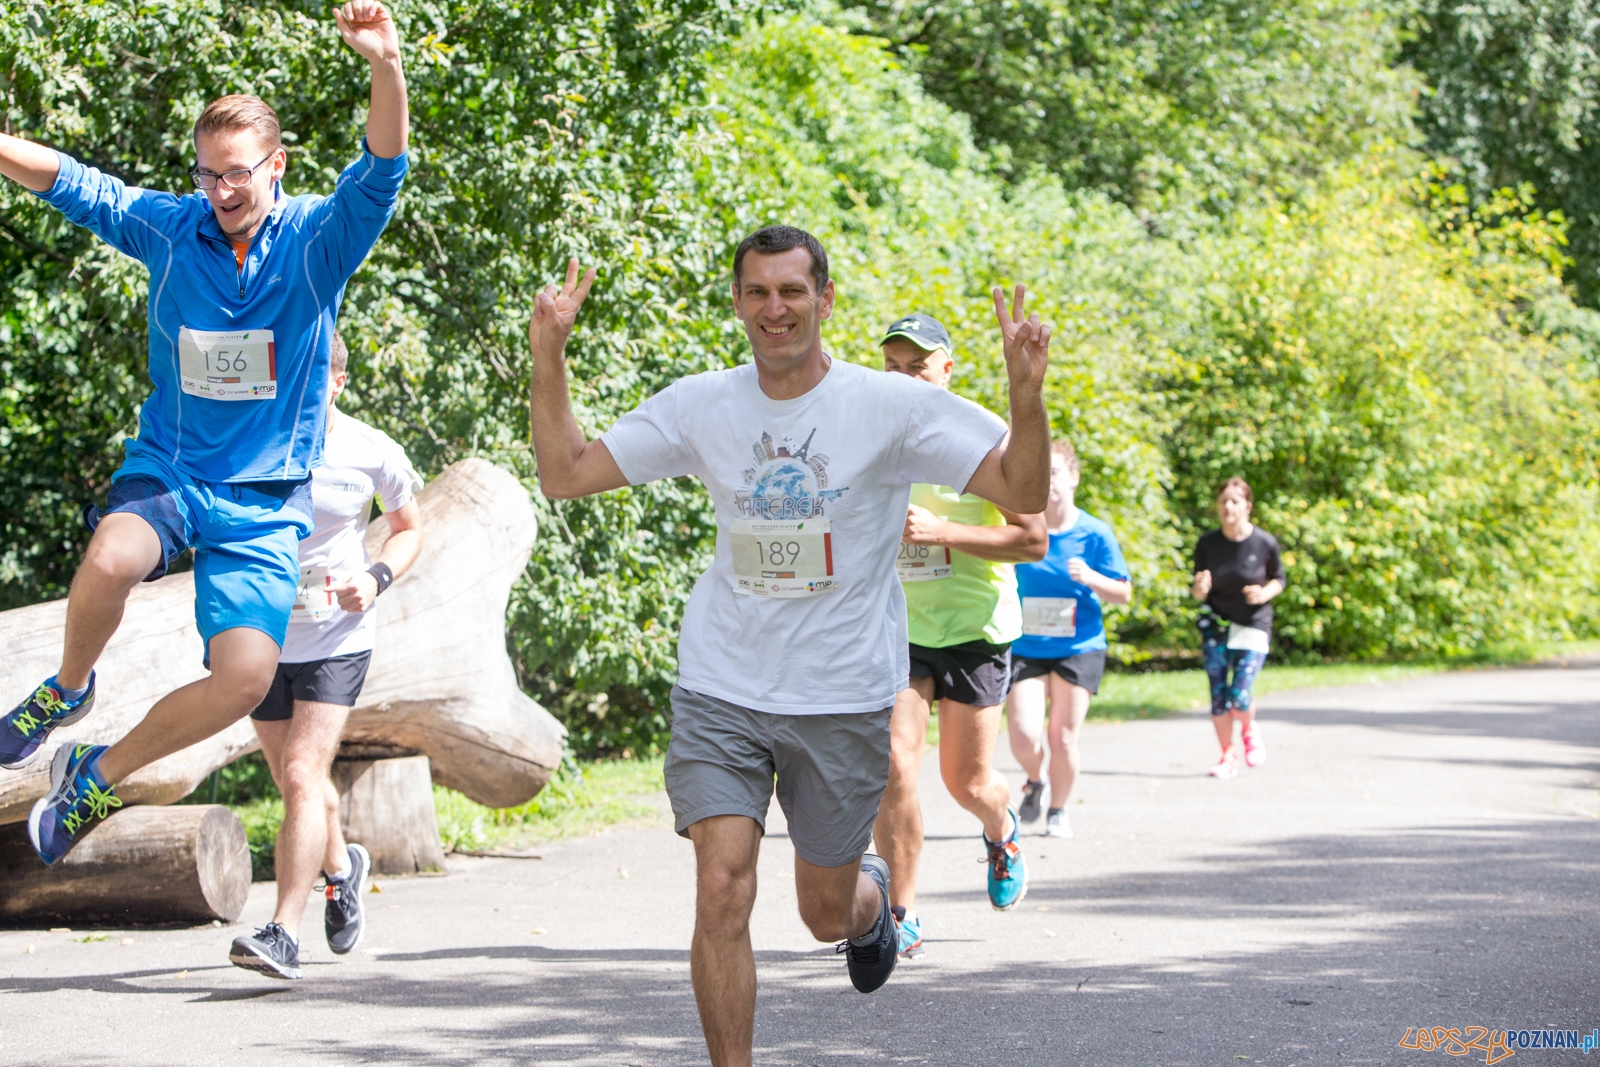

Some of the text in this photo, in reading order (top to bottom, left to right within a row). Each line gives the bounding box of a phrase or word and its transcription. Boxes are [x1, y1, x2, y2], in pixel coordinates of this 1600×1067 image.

[203, 350, 247, 372] 156
[741, 498, 825, 517] PITEREK
[757, 541, 800, 566] 189
[898, 542, 929, 559] 208
[815, 580, 832, 588] mjp
